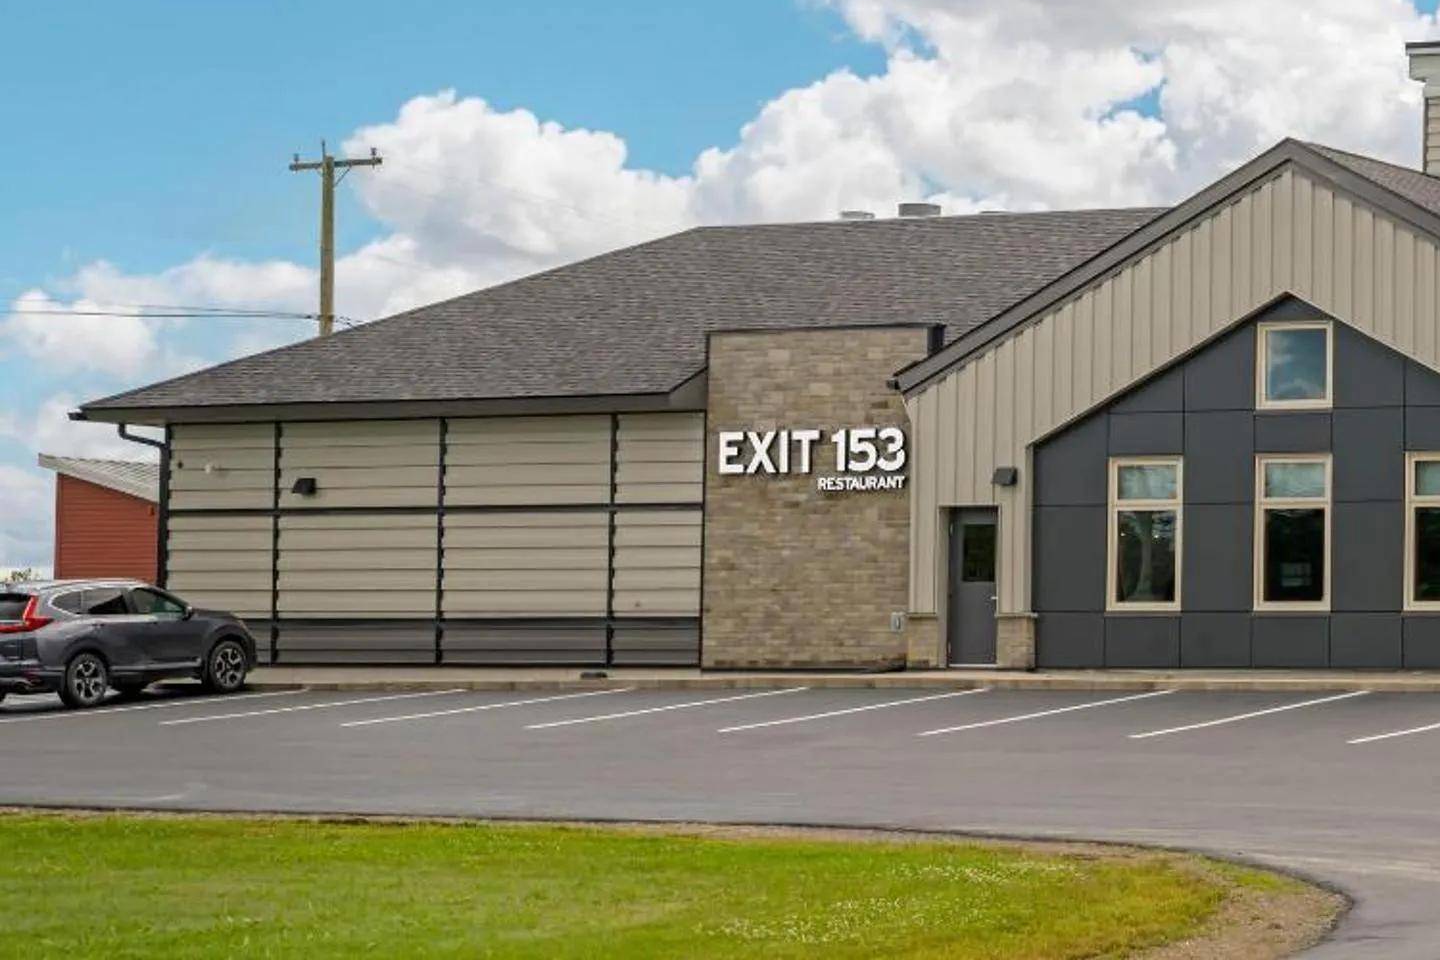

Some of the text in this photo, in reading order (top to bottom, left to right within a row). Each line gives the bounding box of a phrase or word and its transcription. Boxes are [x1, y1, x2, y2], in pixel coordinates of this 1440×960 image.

[718, 427, 906, 474] EXIT 153
[817, 475, 906, 492] RESTAURANT
